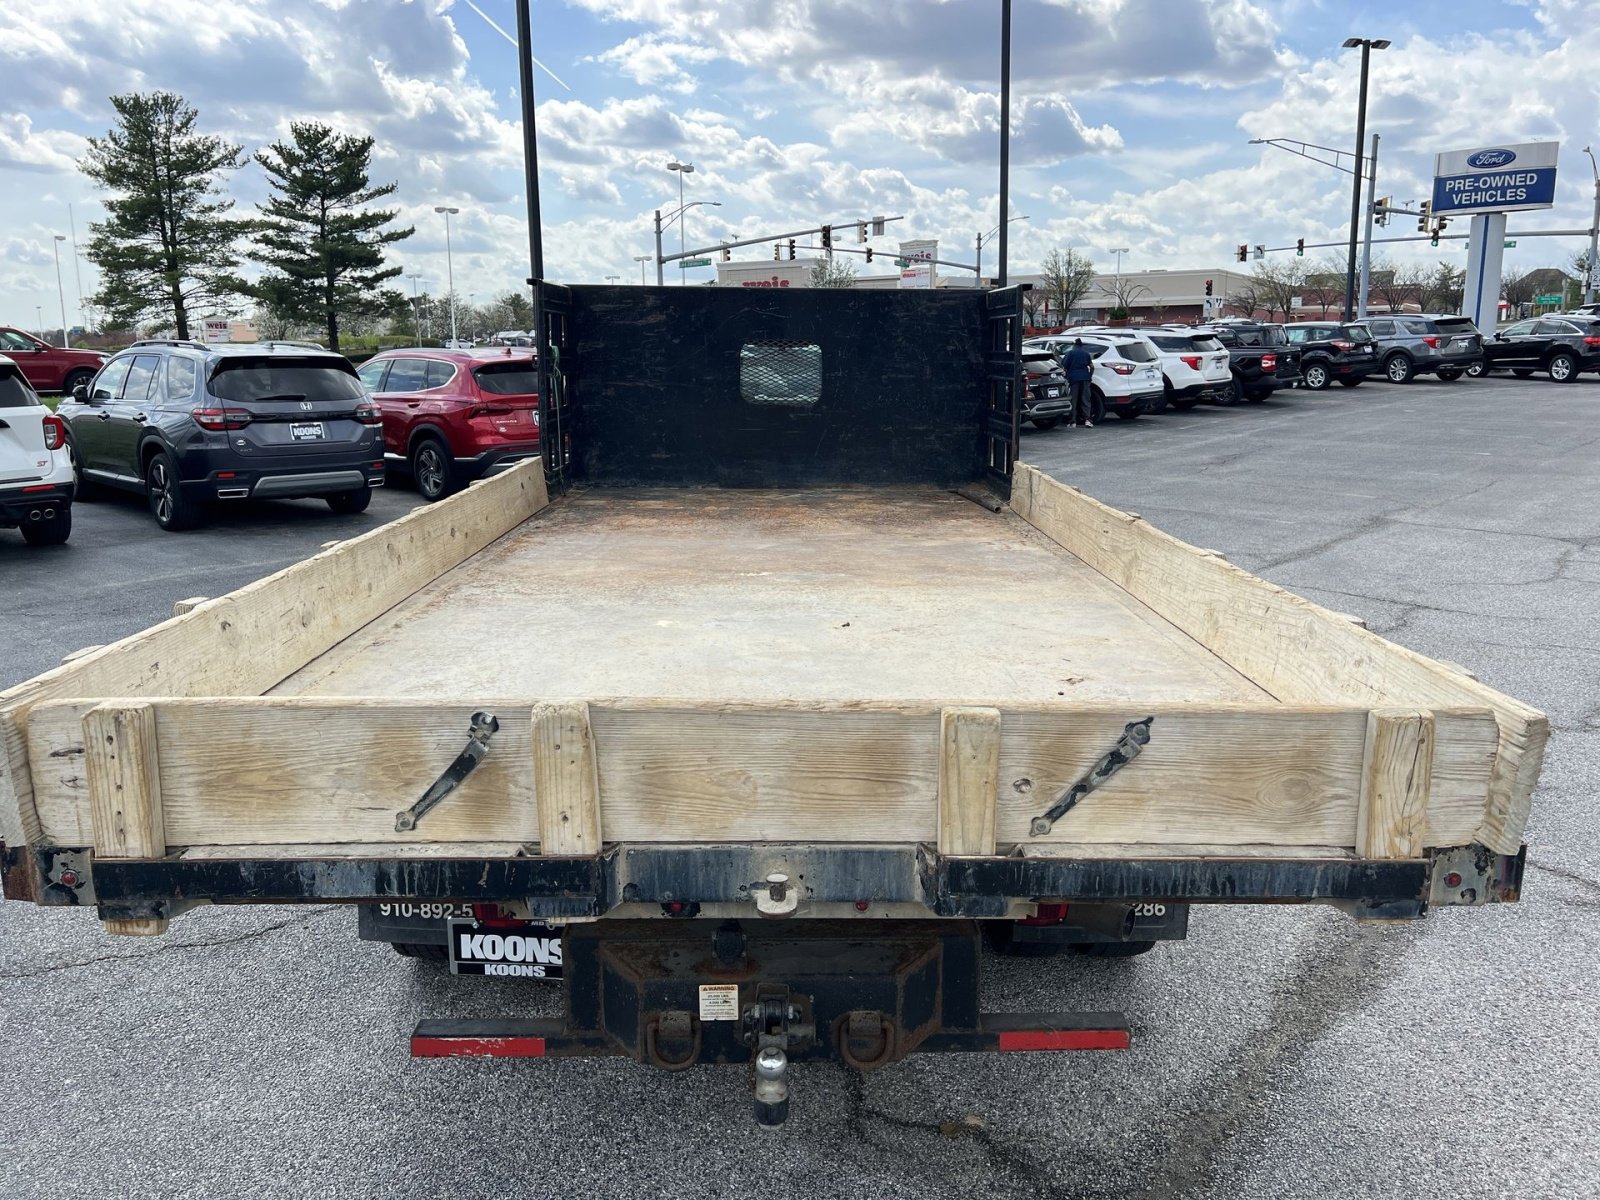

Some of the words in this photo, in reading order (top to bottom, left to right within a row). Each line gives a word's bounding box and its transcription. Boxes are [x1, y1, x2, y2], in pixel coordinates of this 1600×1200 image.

[1475, 151, 1506, 166] Ford
[1445, 173, 1538, 192] PRE-OWNED
[1452, 188, 1527, 206] VEHICLES
[206, 321, 228, 330] weis
[293, 425, 322, 437] KOONS
[36, 460, 49, 468] ST
[460, 934, 563, 965] KOONS
[484, 963, 546, 977] KOONS
